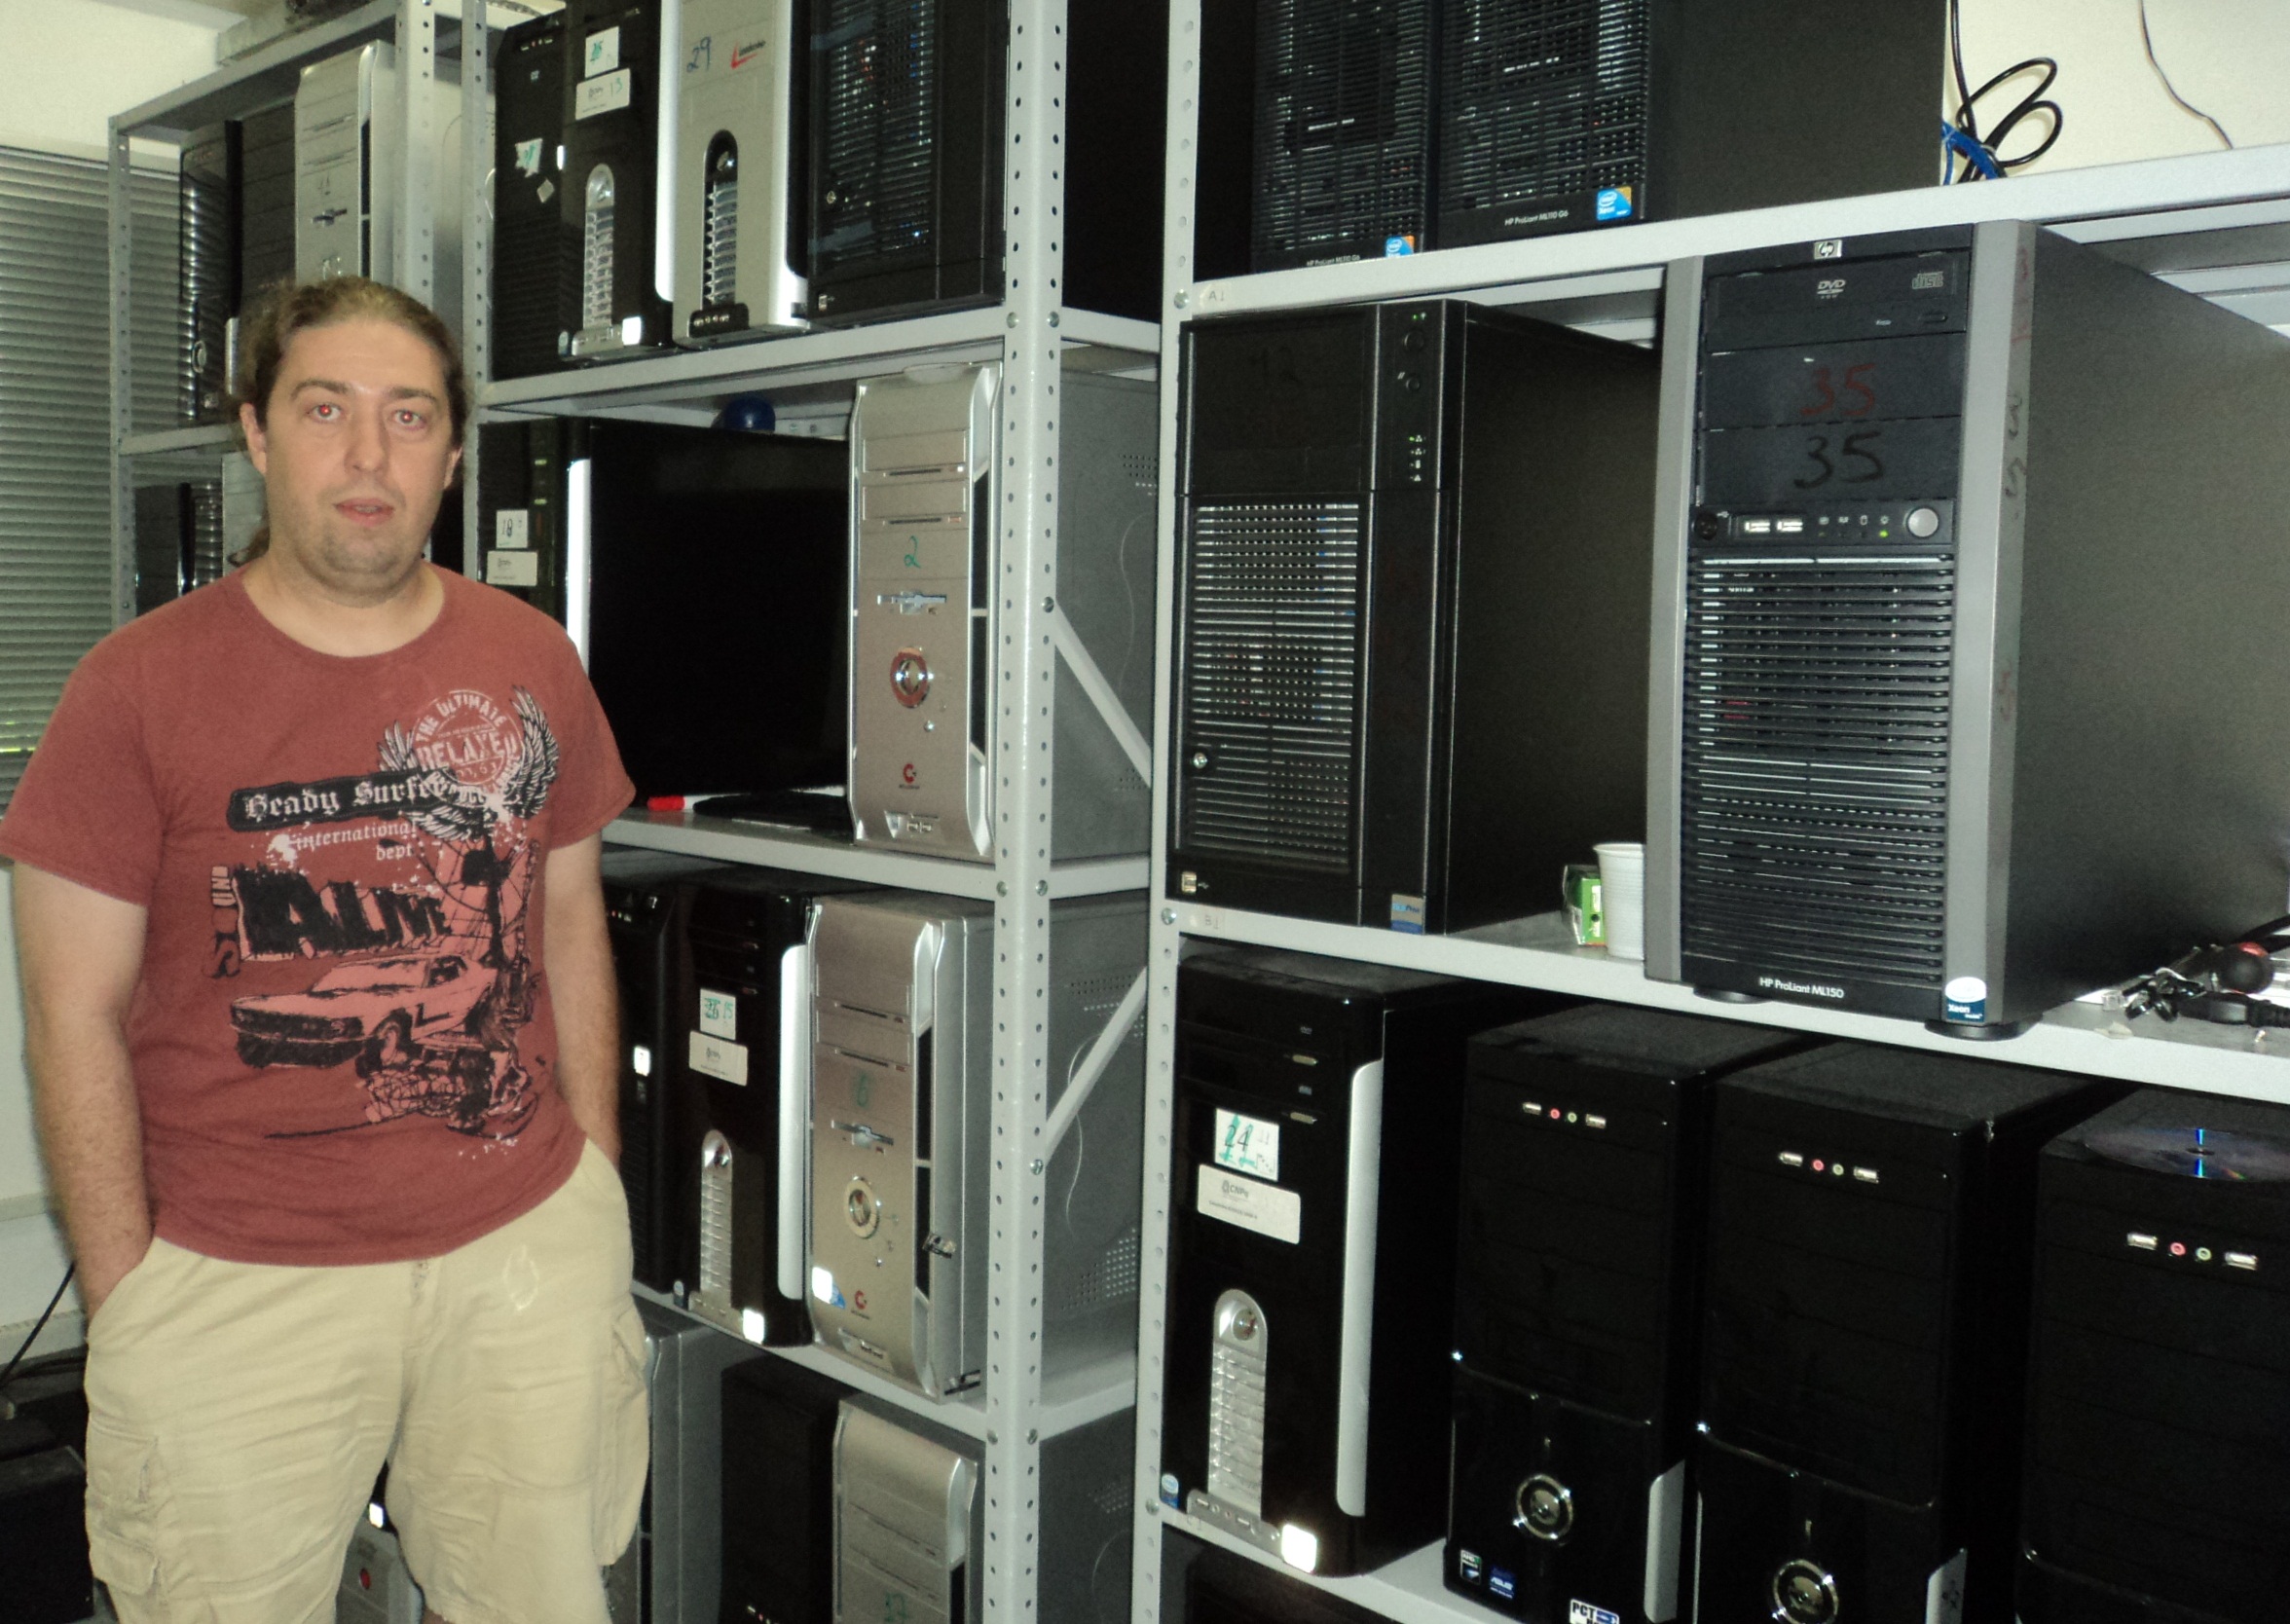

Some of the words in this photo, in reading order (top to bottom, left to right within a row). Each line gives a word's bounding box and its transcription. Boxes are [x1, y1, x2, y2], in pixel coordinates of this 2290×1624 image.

[685, 36, 712, 72] 29
[1514, 213, 1539, 225] ProLiant
[1817, 278, 1846, 290] DVD
[1802, 362, 1876, 417] 35
[1794, 431, 1886, 489] 35
[903, 535, 922, 569] 2
[415, 713, 440, 743] THE
[435, 692, 508, 728] ULTIMATE
[1758, 977, 1774, 988] HP
[1774, 978, 1811, 994] ProLiant
[1811, 984, 1845, 999] ML150
[1571, 1602, 1597, 1620] PCT
